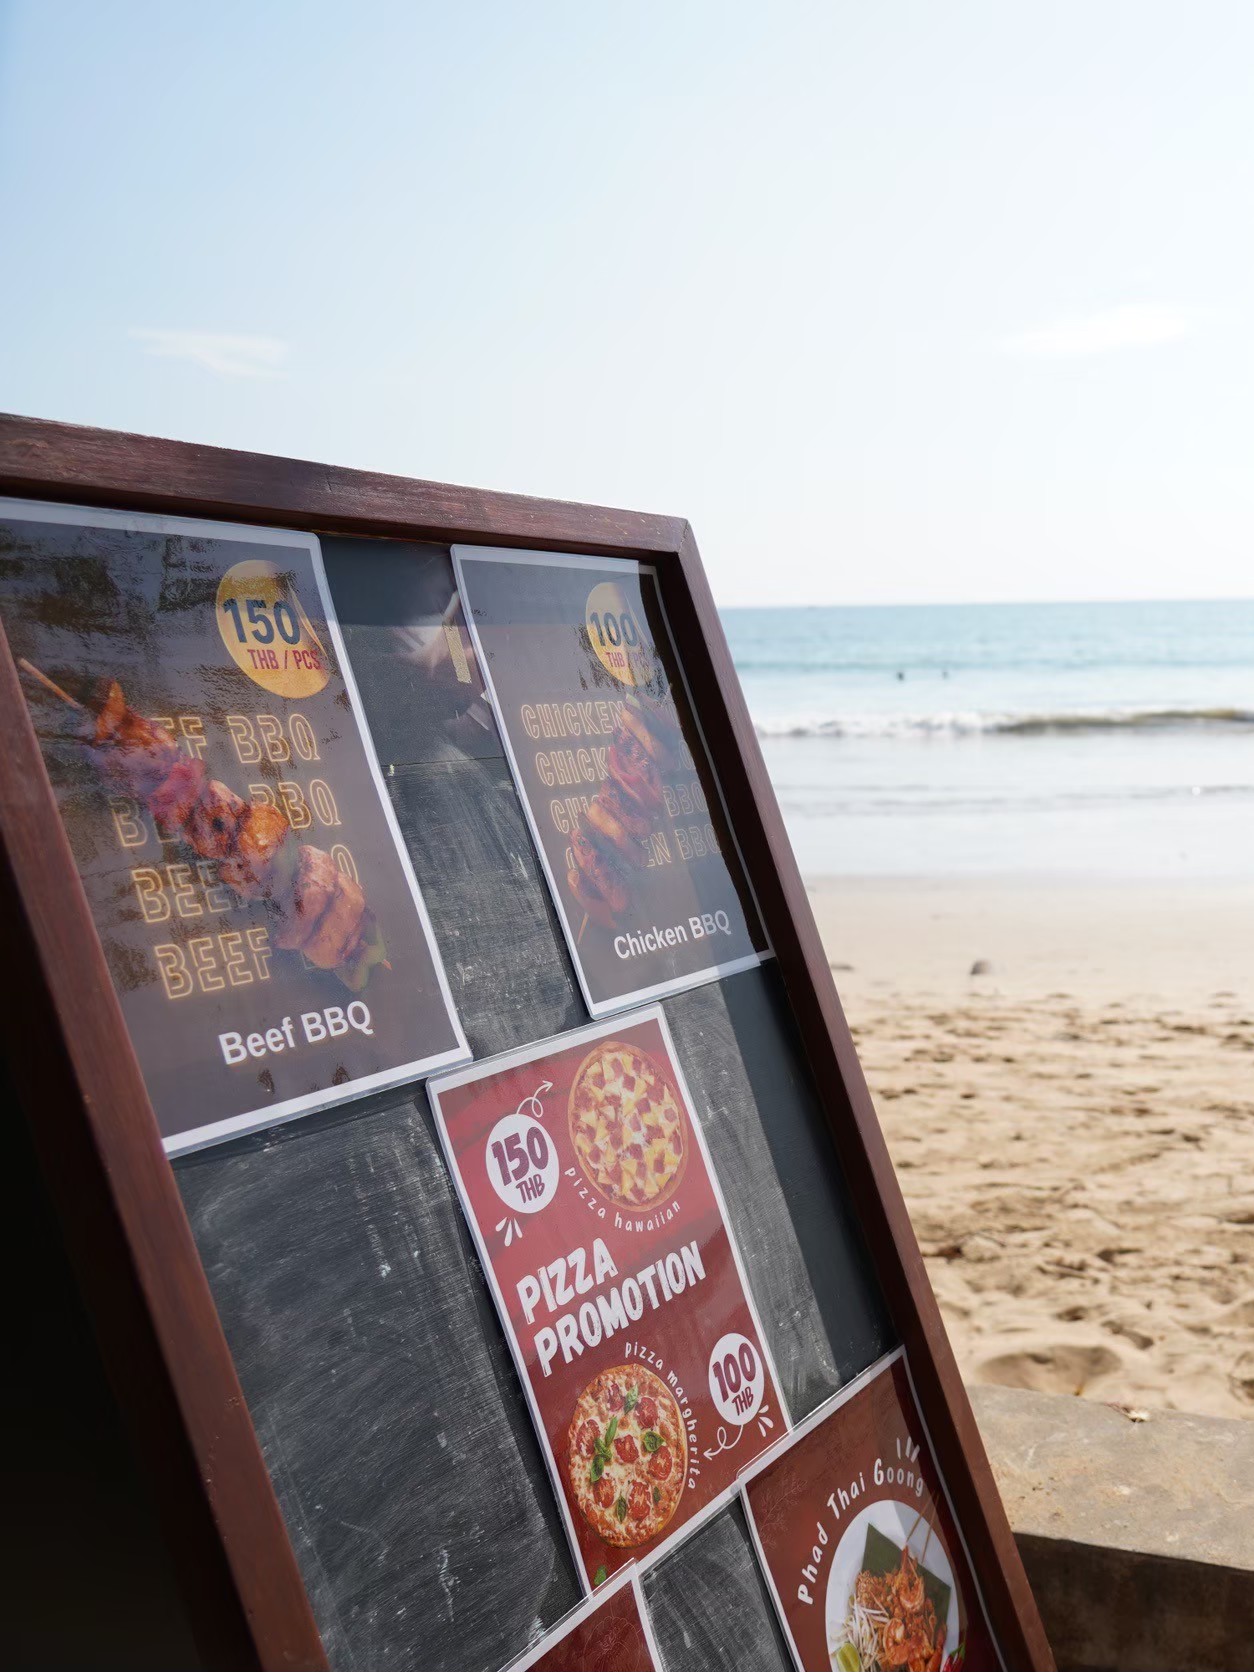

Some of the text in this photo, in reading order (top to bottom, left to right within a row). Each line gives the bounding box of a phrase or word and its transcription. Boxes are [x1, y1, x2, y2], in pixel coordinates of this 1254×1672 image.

[223, 598, 301, 645] 150
[590, 612, 638, 647] 100
[247, 648, 280, 670] THB
[291, 650, 322, 671] PCS
[605, 652, 626, 668] THB
[227, 713, 321, 764] BBQ
[154, 927, 273, 1000] BEEF
[613, 909, 732, 959] Chicken BBQ
[218, 1000, 375, 1065] Beef BBQ
[491, 1126, 549, 1187] 150
[515, 1173, 546, 1204] THB
[564, 1167, 681, 1232] pizza hawaiian
[516, 1237, 619, 1325] PIZZA
[533, 1240, 707, 1378] PROMOTION
[712, 1342, 757, 1403] 100
[731, 1386, 754, 1416] THB
[624, 1341, 701, 1489] pizza margherita
[797, 1457, 924, 1605] Phad Thai Goong
